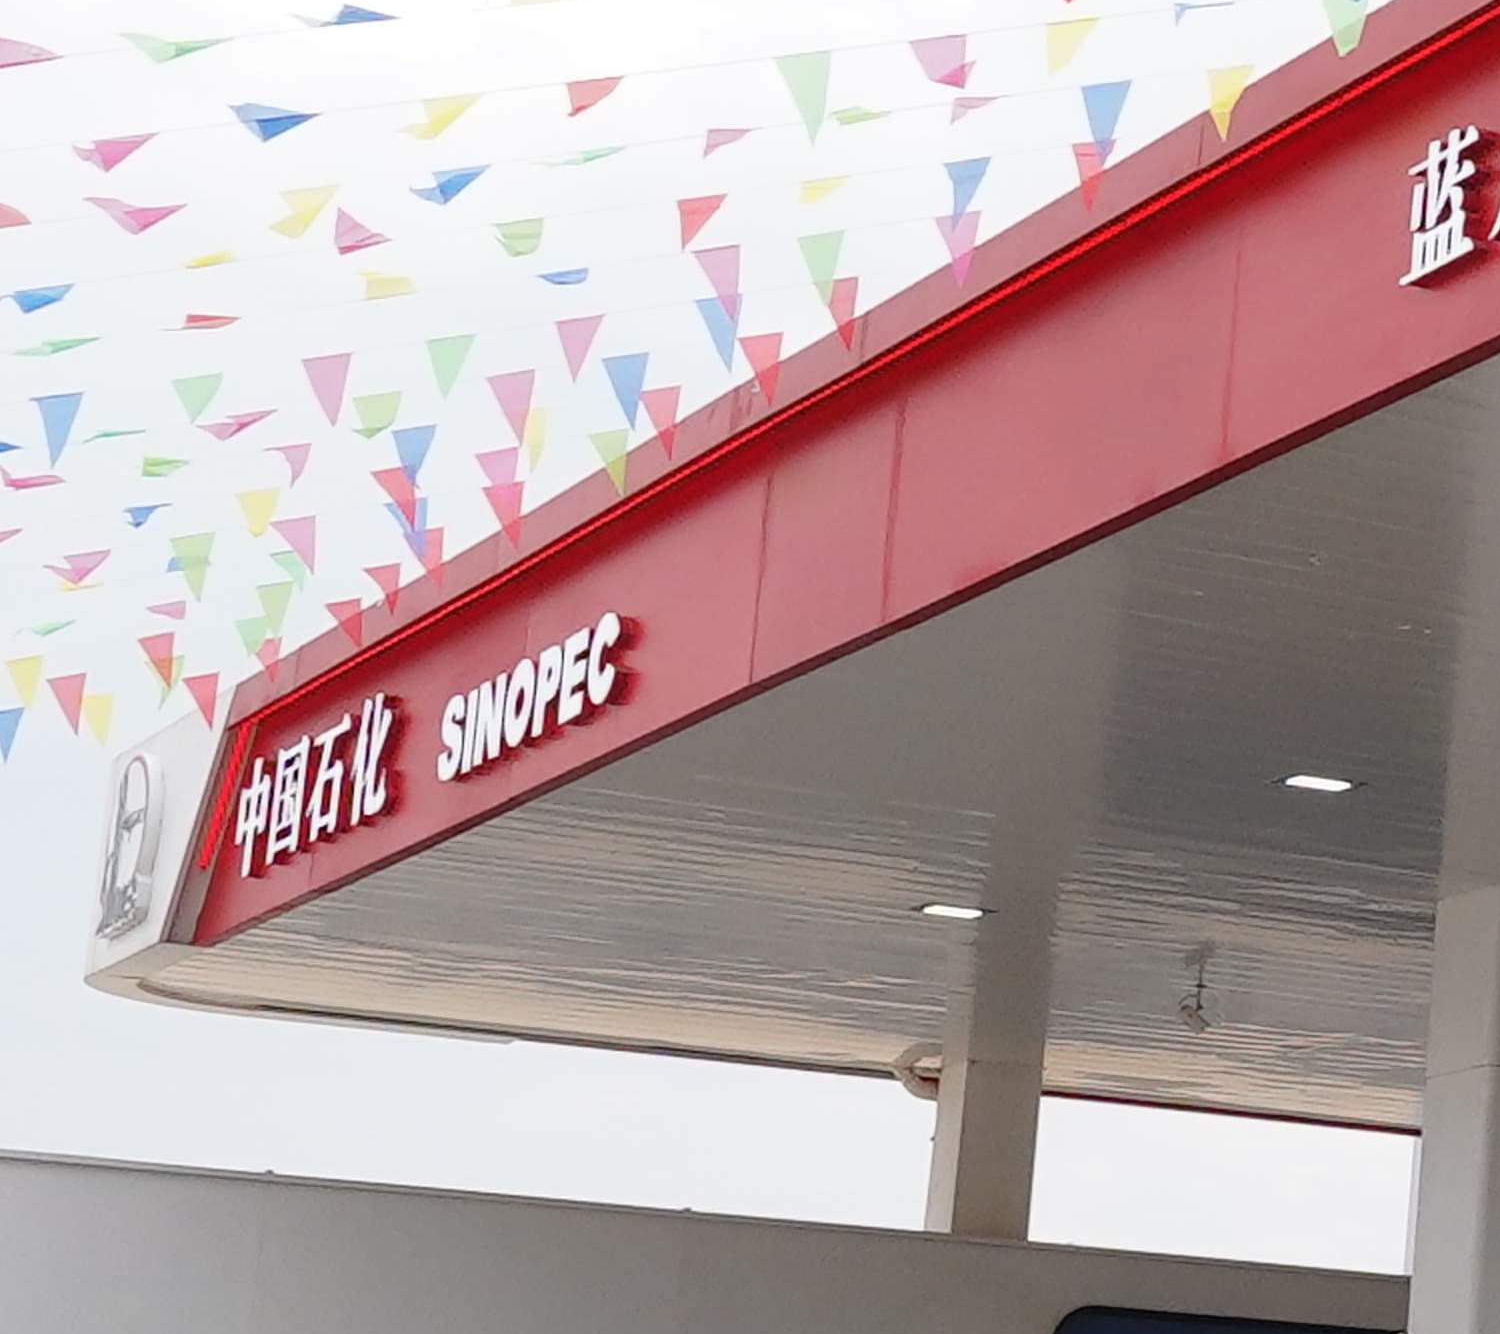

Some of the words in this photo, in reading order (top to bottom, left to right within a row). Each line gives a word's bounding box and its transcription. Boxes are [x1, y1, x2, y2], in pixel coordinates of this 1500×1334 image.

[234, 692, 395, 878] 中国石化
[436, 611, 622, 782] SINOPEC
